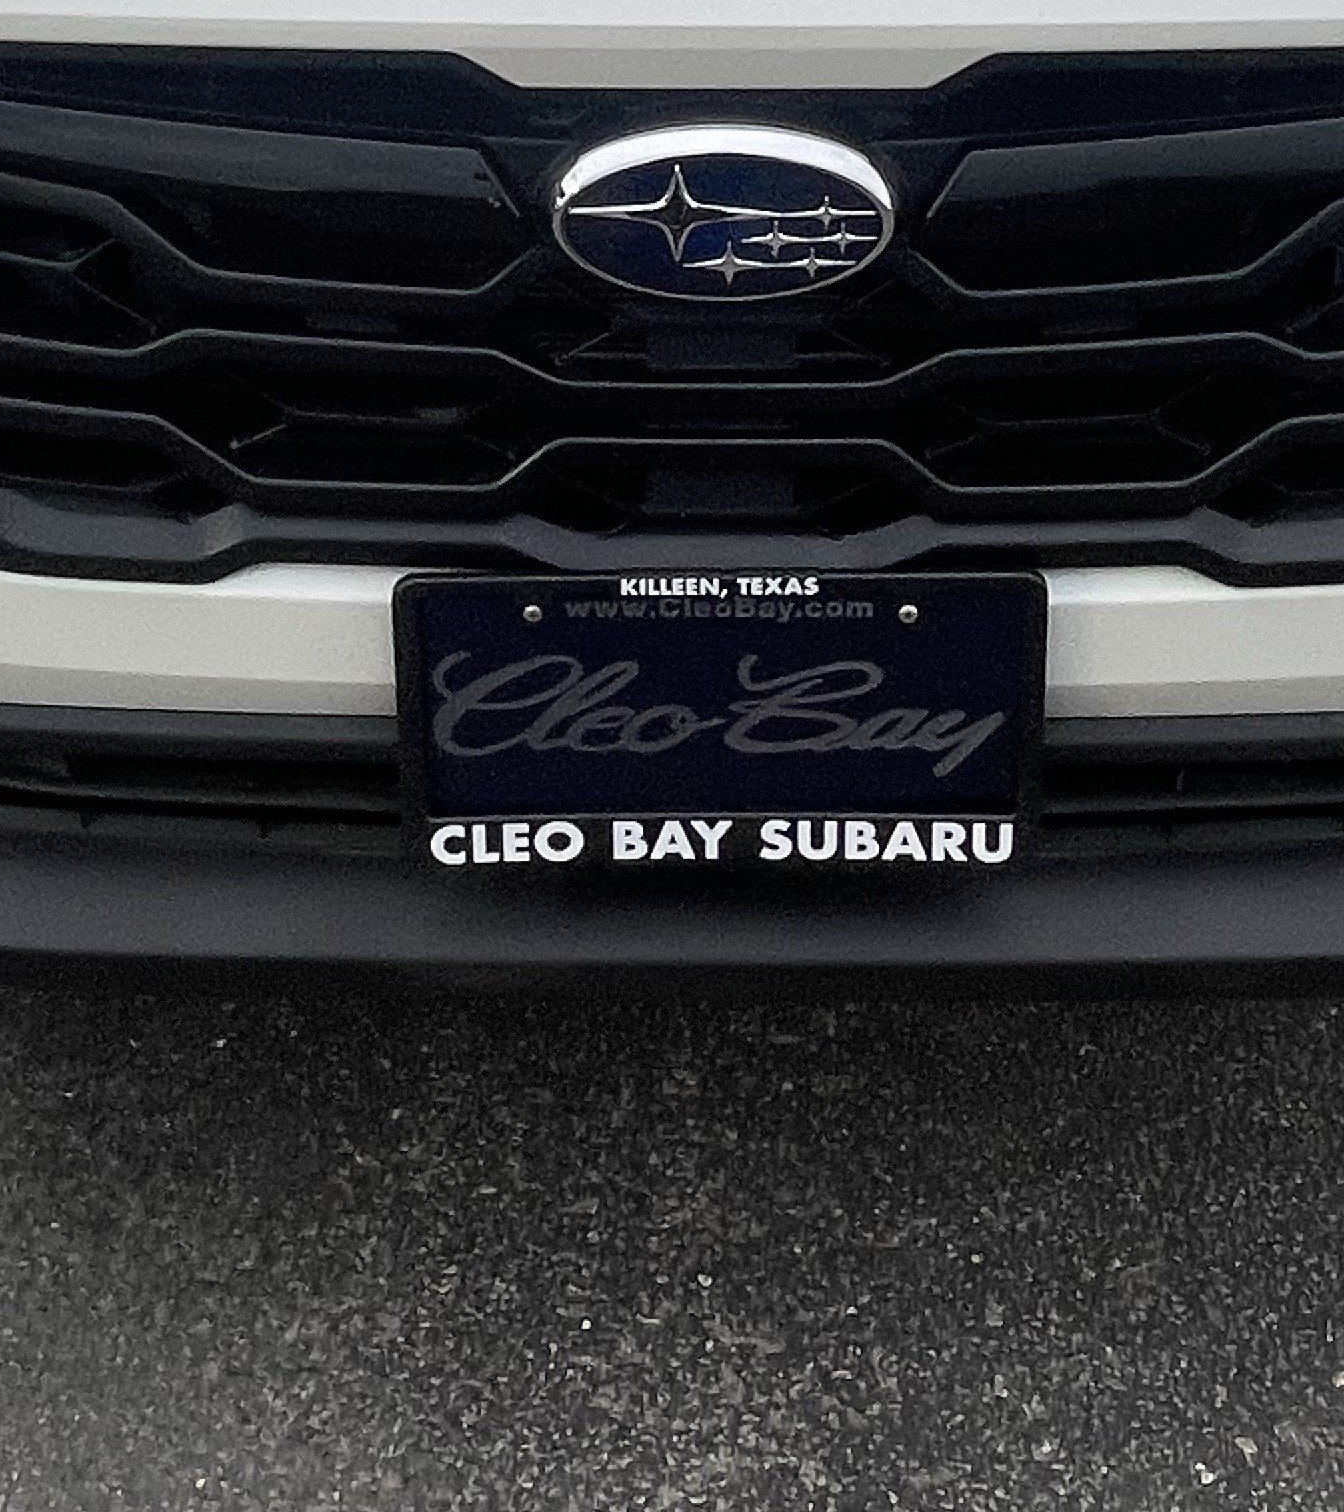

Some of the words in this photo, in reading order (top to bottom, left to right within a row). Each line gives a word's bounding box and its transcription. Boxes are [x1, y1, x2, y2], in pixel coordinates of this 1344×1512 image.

[620, 577, 728, 599] KILLEEN,
[736, 576, 820, 596] TEXAS
[564, 598, 874, 623] www.CleoBay.com
[432, 650, 726, 757] Cleo
[723, 654, 1006, 778] Bay
[430, 821, 584, 866] CLEO
[612, 821, 733, 861] BAY
[759, 820, 1014, 864] SUBARU
